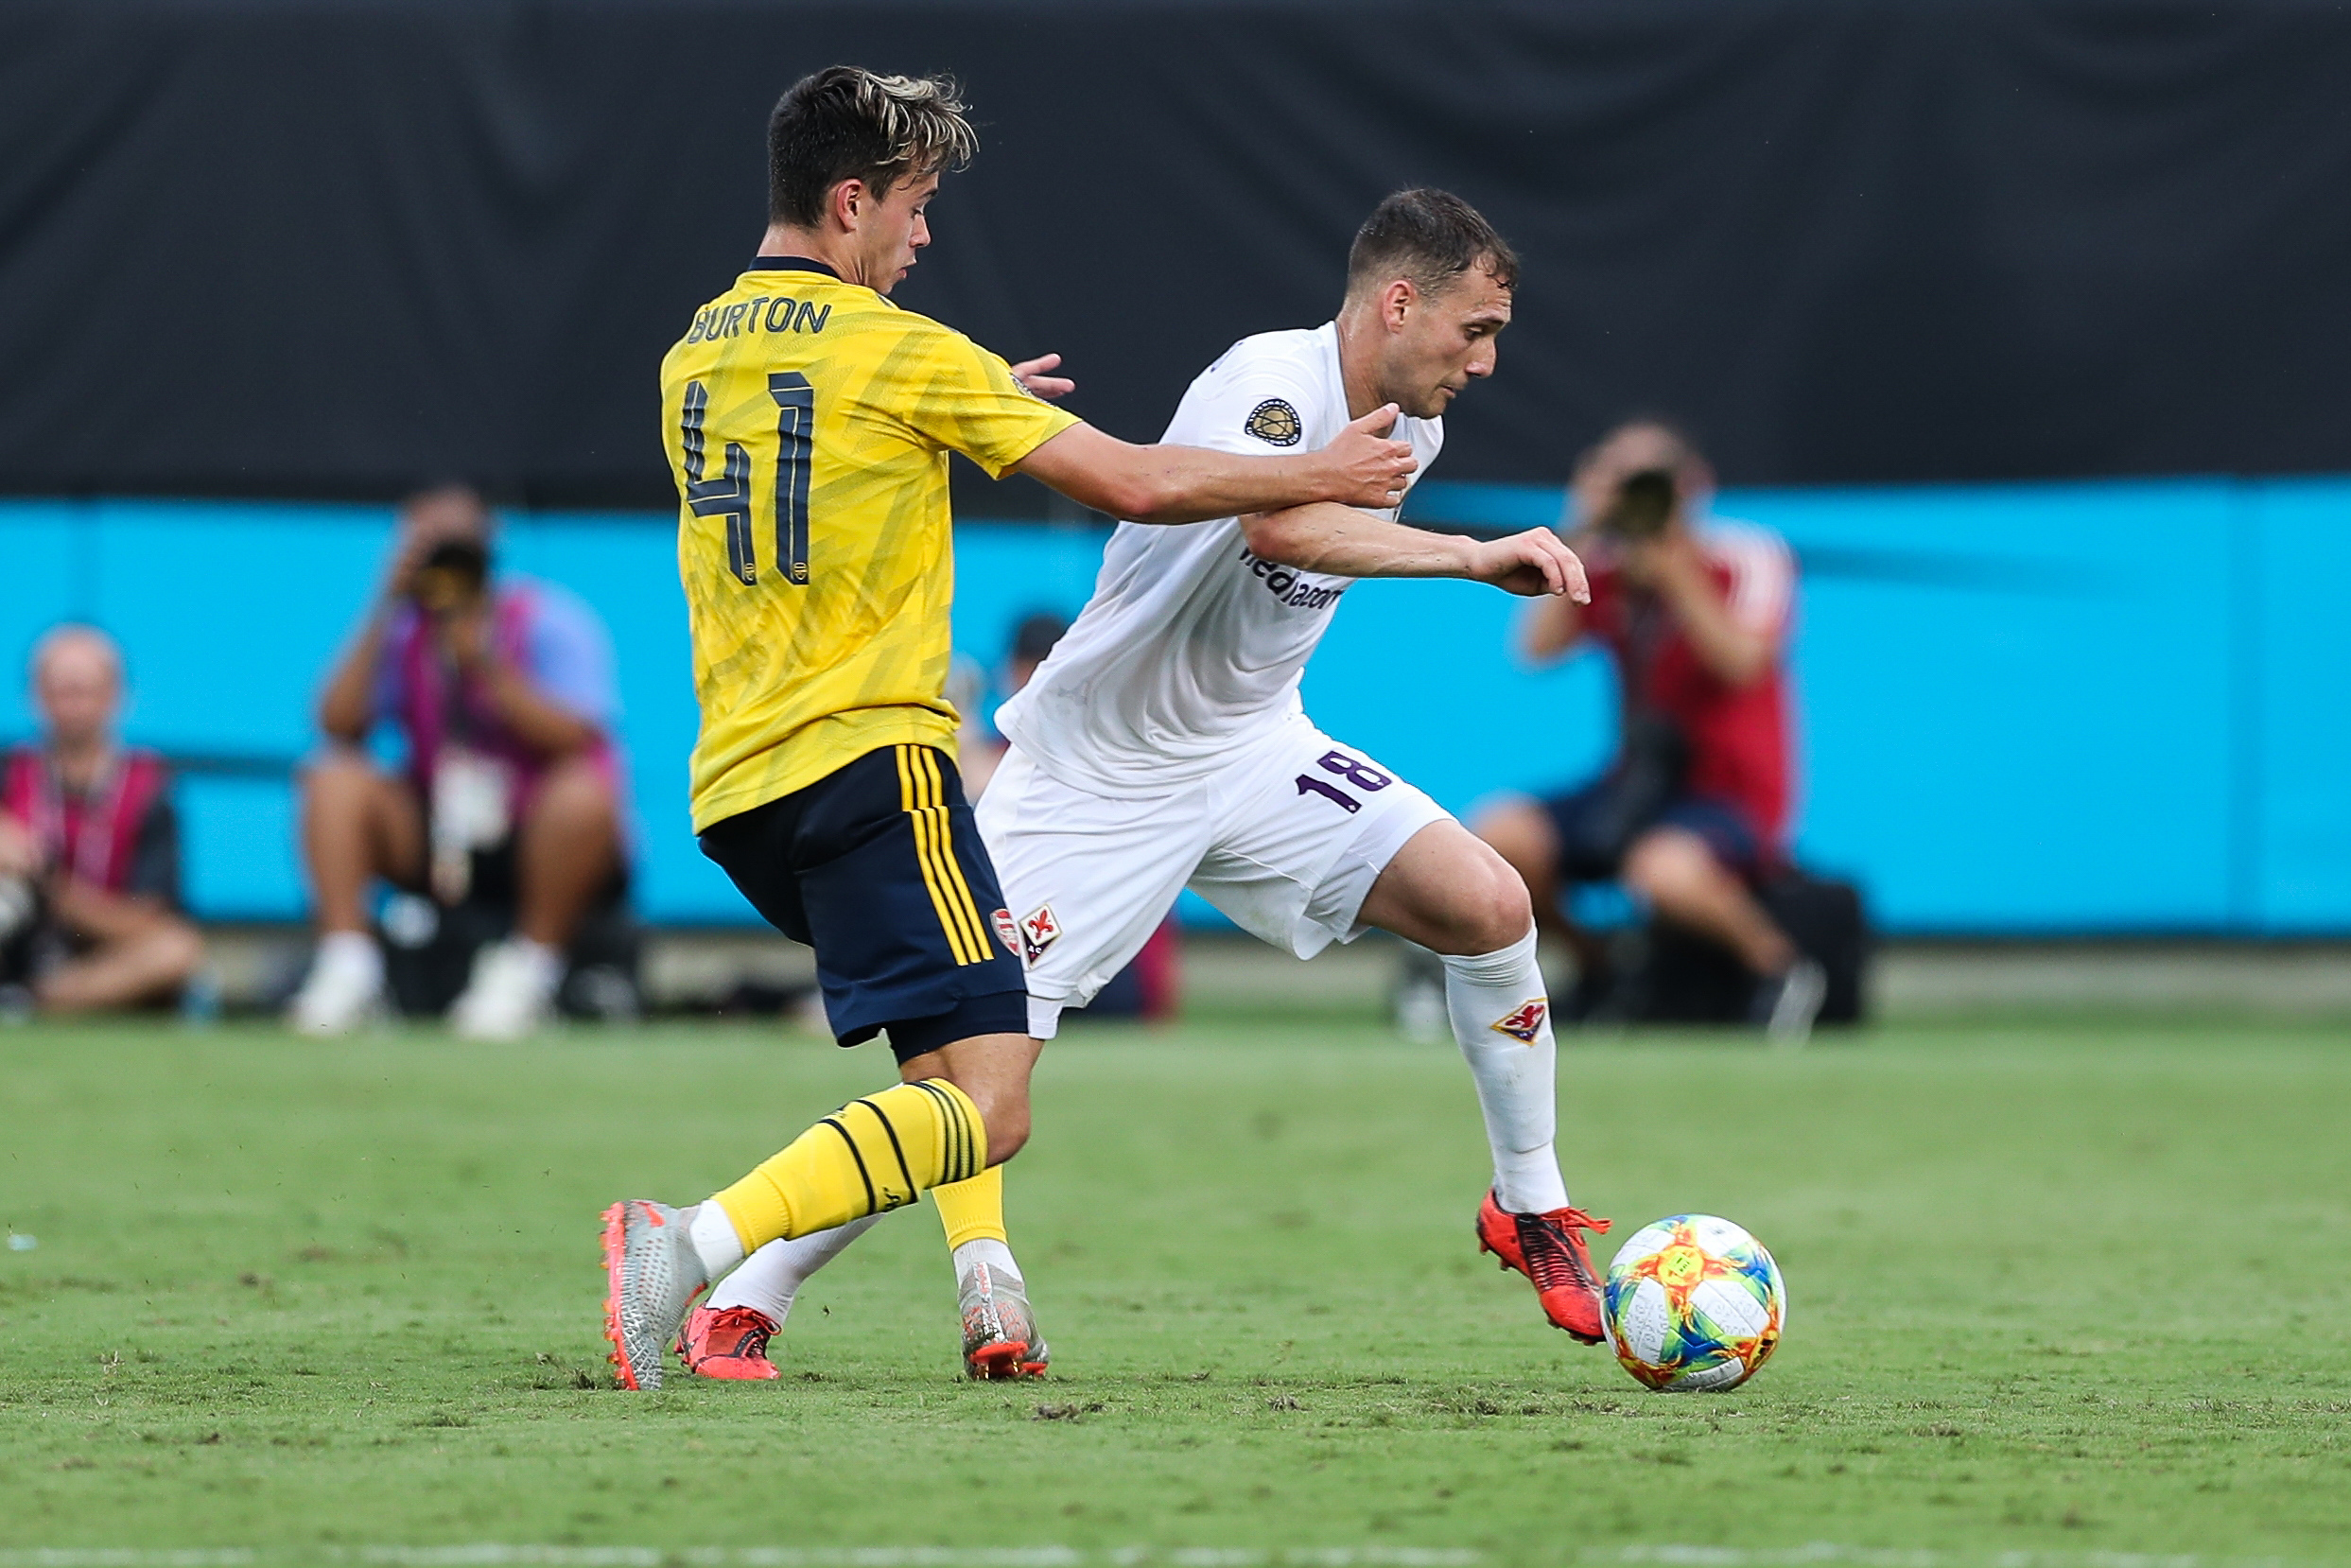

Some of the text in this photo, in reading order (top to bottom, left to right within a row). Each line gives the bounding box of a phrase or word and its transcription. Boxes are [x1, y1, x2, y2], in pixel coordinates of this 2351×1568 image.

[688, 297, 832, 344] BURTON
[681, 371, 814, 585] 41
[1294, 750, 1392, 814] 18
